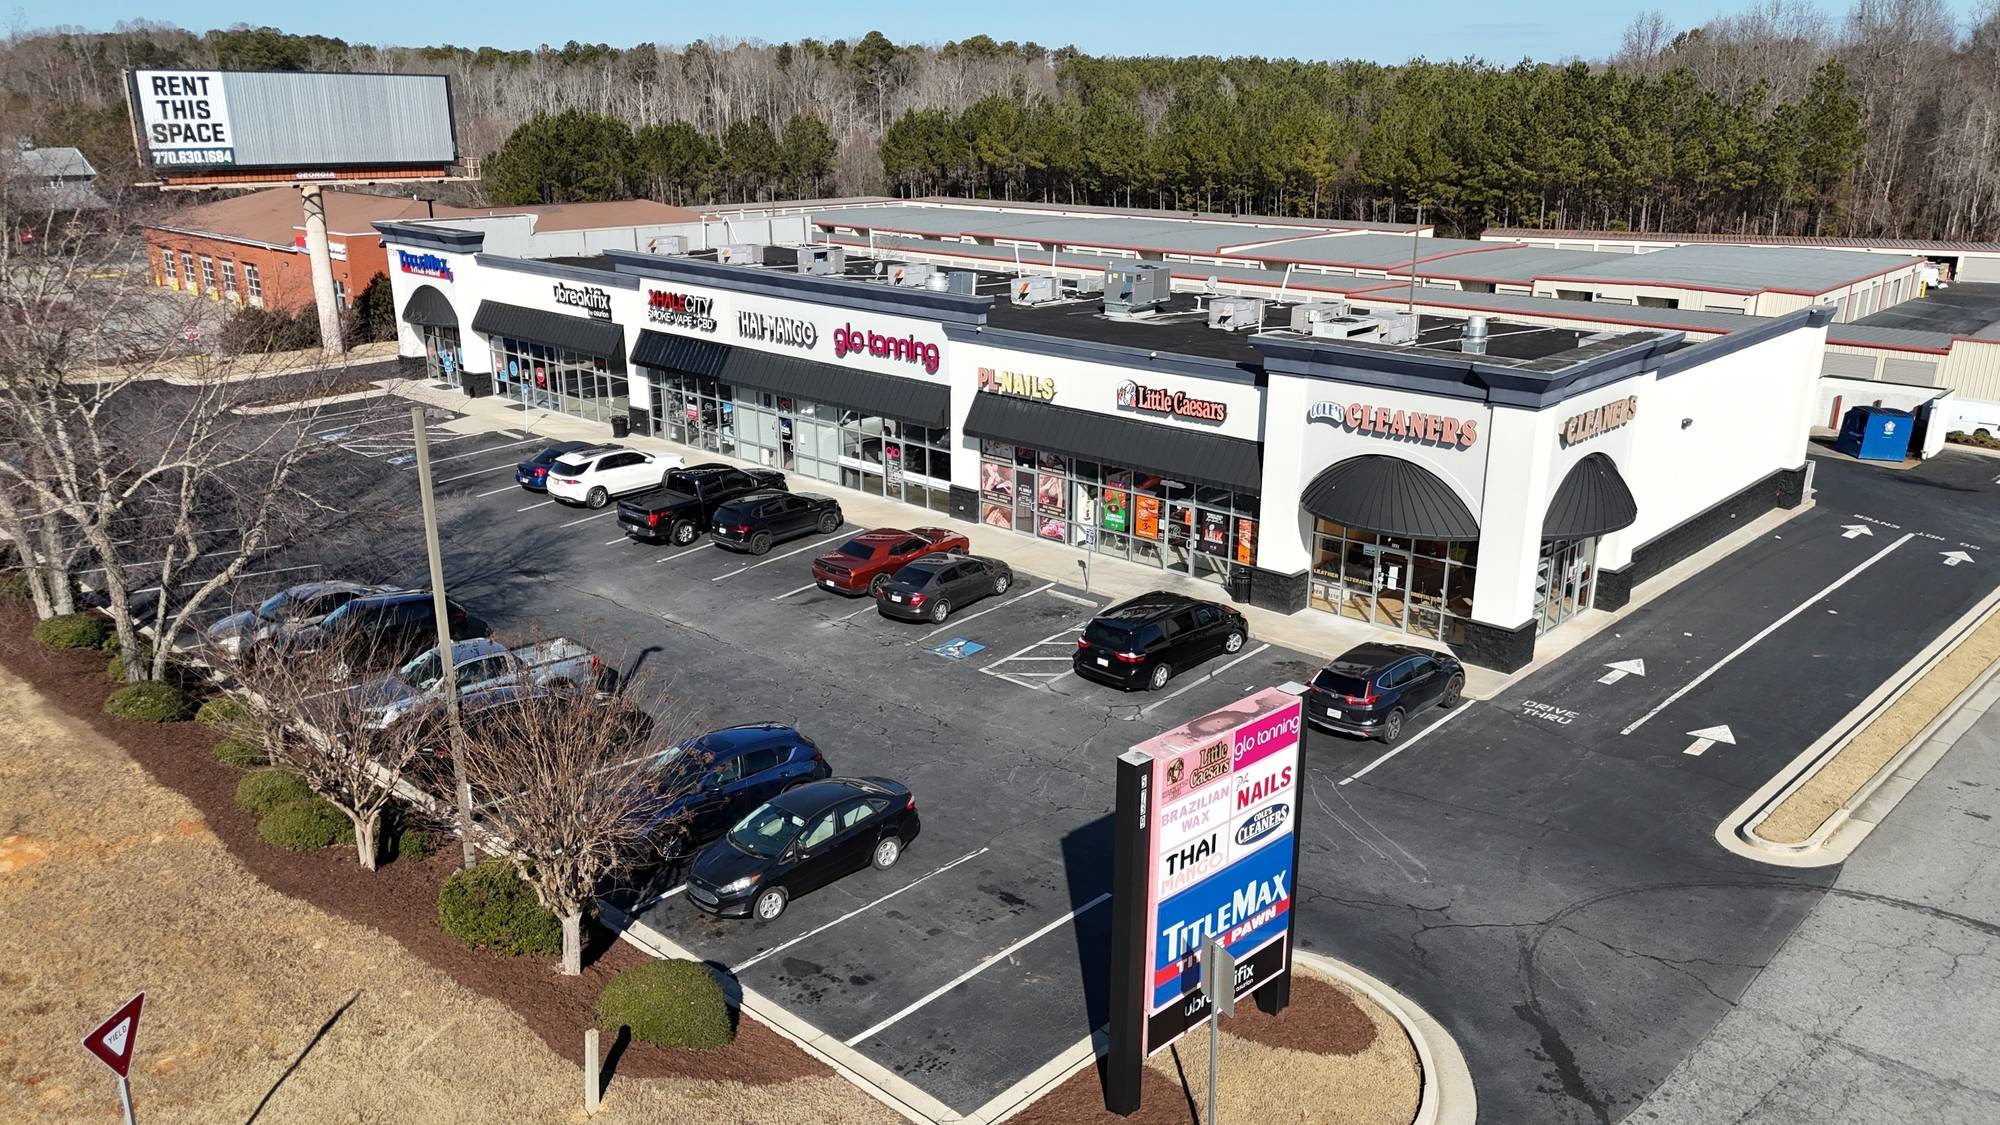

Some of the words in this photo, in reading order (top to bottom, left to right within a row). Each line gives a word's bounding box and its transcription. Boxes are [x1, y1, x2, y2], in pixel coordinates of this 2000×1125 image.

[151, 76, 209, 96] RENT
[156, 100, 211, 120] THIS
[152, 123, 226, 143] SPACE
[834, 322, 864, 358] glo
[868, 330, 940, 374] tanning
[1138, 386, 1172, 413] Little
[1173, 391, 1227, 422] Caesars
[1567, 395, 1638, 446] CLEANERS
[1345, 402, 1478, 447] CLEANERS
[1522, 700, 1580, 719] DRIVE
[1522, 708, 1573, 725] THRU
[1199, 741, 1229, 769] Little
[1234, 735, 1255, 762] glo
[1257, 716, 1300, 746] tanning
[1189, 759, 1230, 789] Caesars
[1237, 765, 1292, 811] NAILS
[1161, 786, 1230, 828] BRAZILIAN
[1182, 809, 1211, 833] WAX
[1237, 804, 1289, 845] CLEANERS
[1165, 833, 1217, 876] THAI
[1161, 852, 1224, 896] MANGO
[1176, 936, 1226, 974] TITE
[1231, 905, 1277, 946] PAWN
[108, 1024, 128, 1046] YIELD
